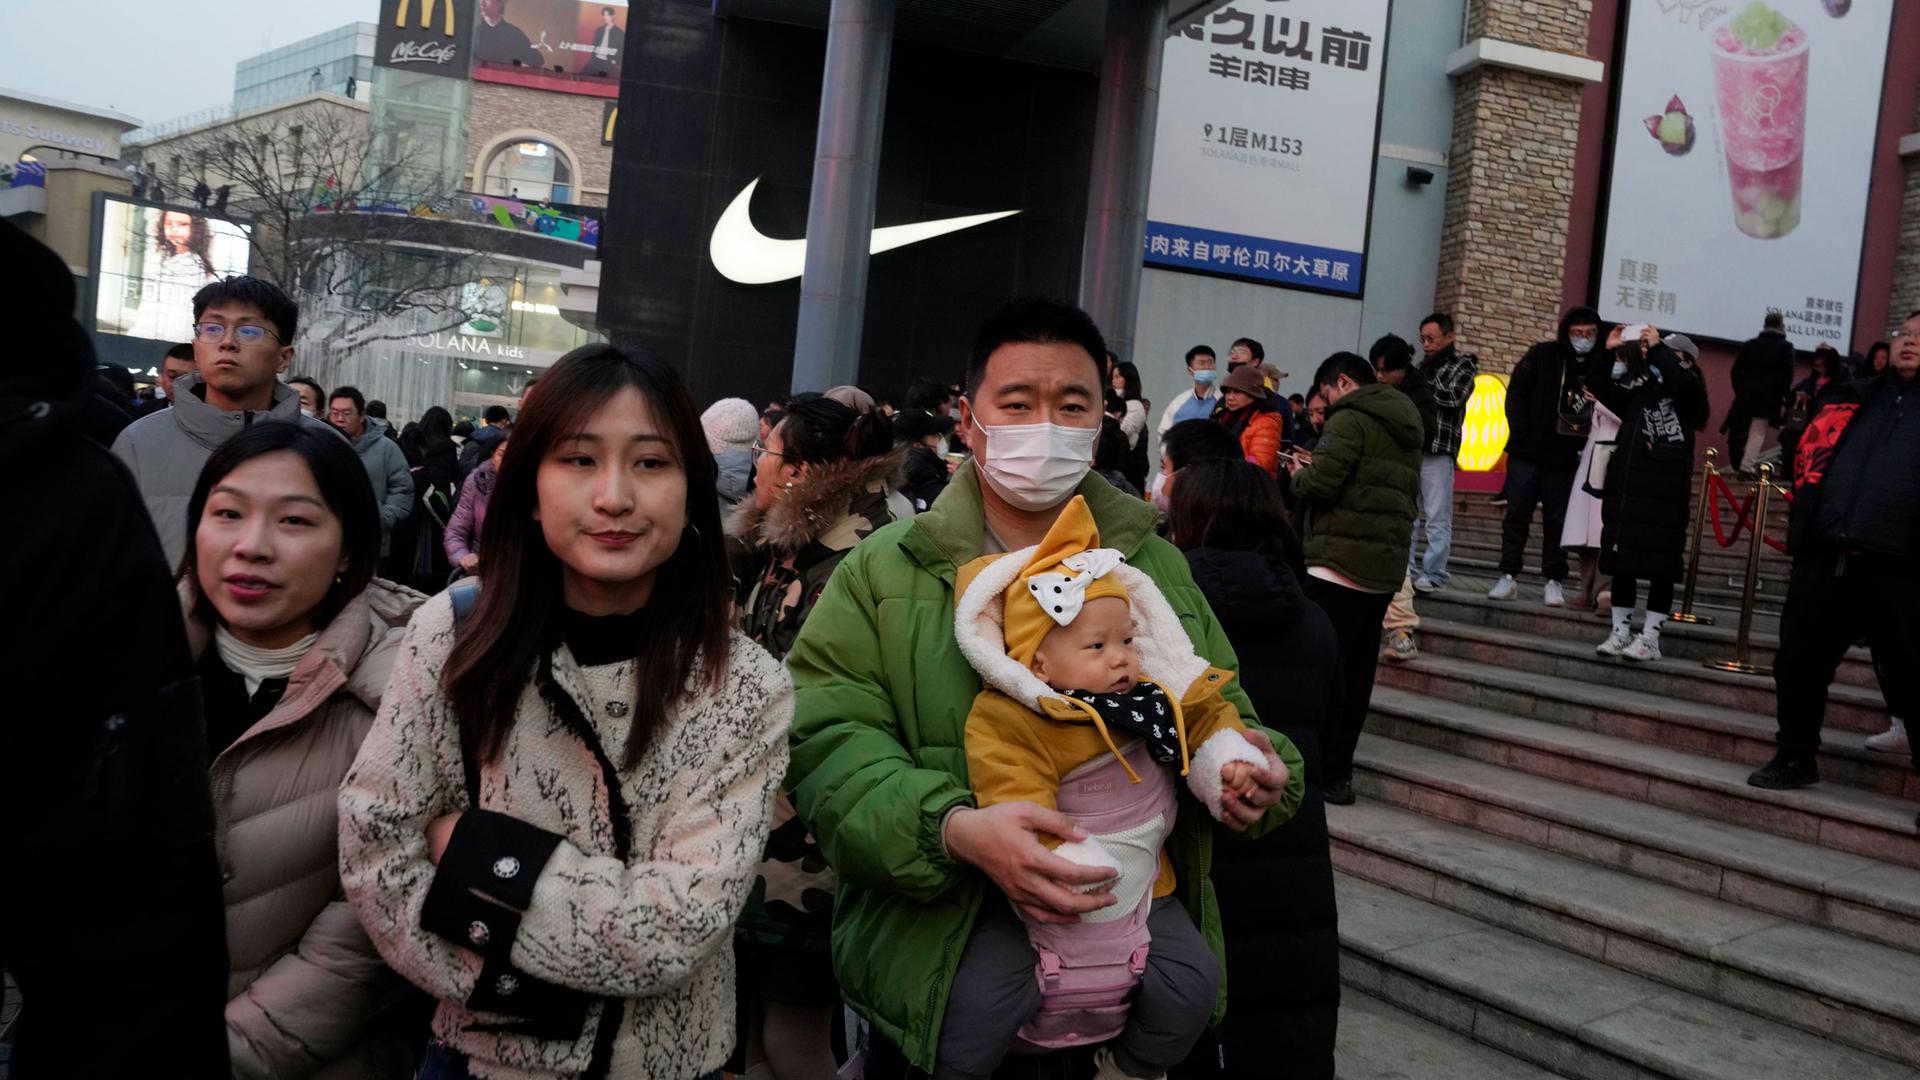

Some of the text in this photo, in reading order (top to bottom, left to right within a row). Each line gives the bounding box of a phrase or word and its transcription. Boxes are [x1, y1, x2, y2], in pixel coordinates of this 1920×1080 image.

[1180, 7, 1372, 71] 久以前
[1209, 53, 1310, 91] 羊肉串
[26, 122, 104, 152] Subway
[1618, 258, 1658, 284] 真果
[1615, 286, 1677, 316] 无香精
[408, 332, 524, 359] SOLANA kids
[1659, 397, 1685, 443] ARTIST
